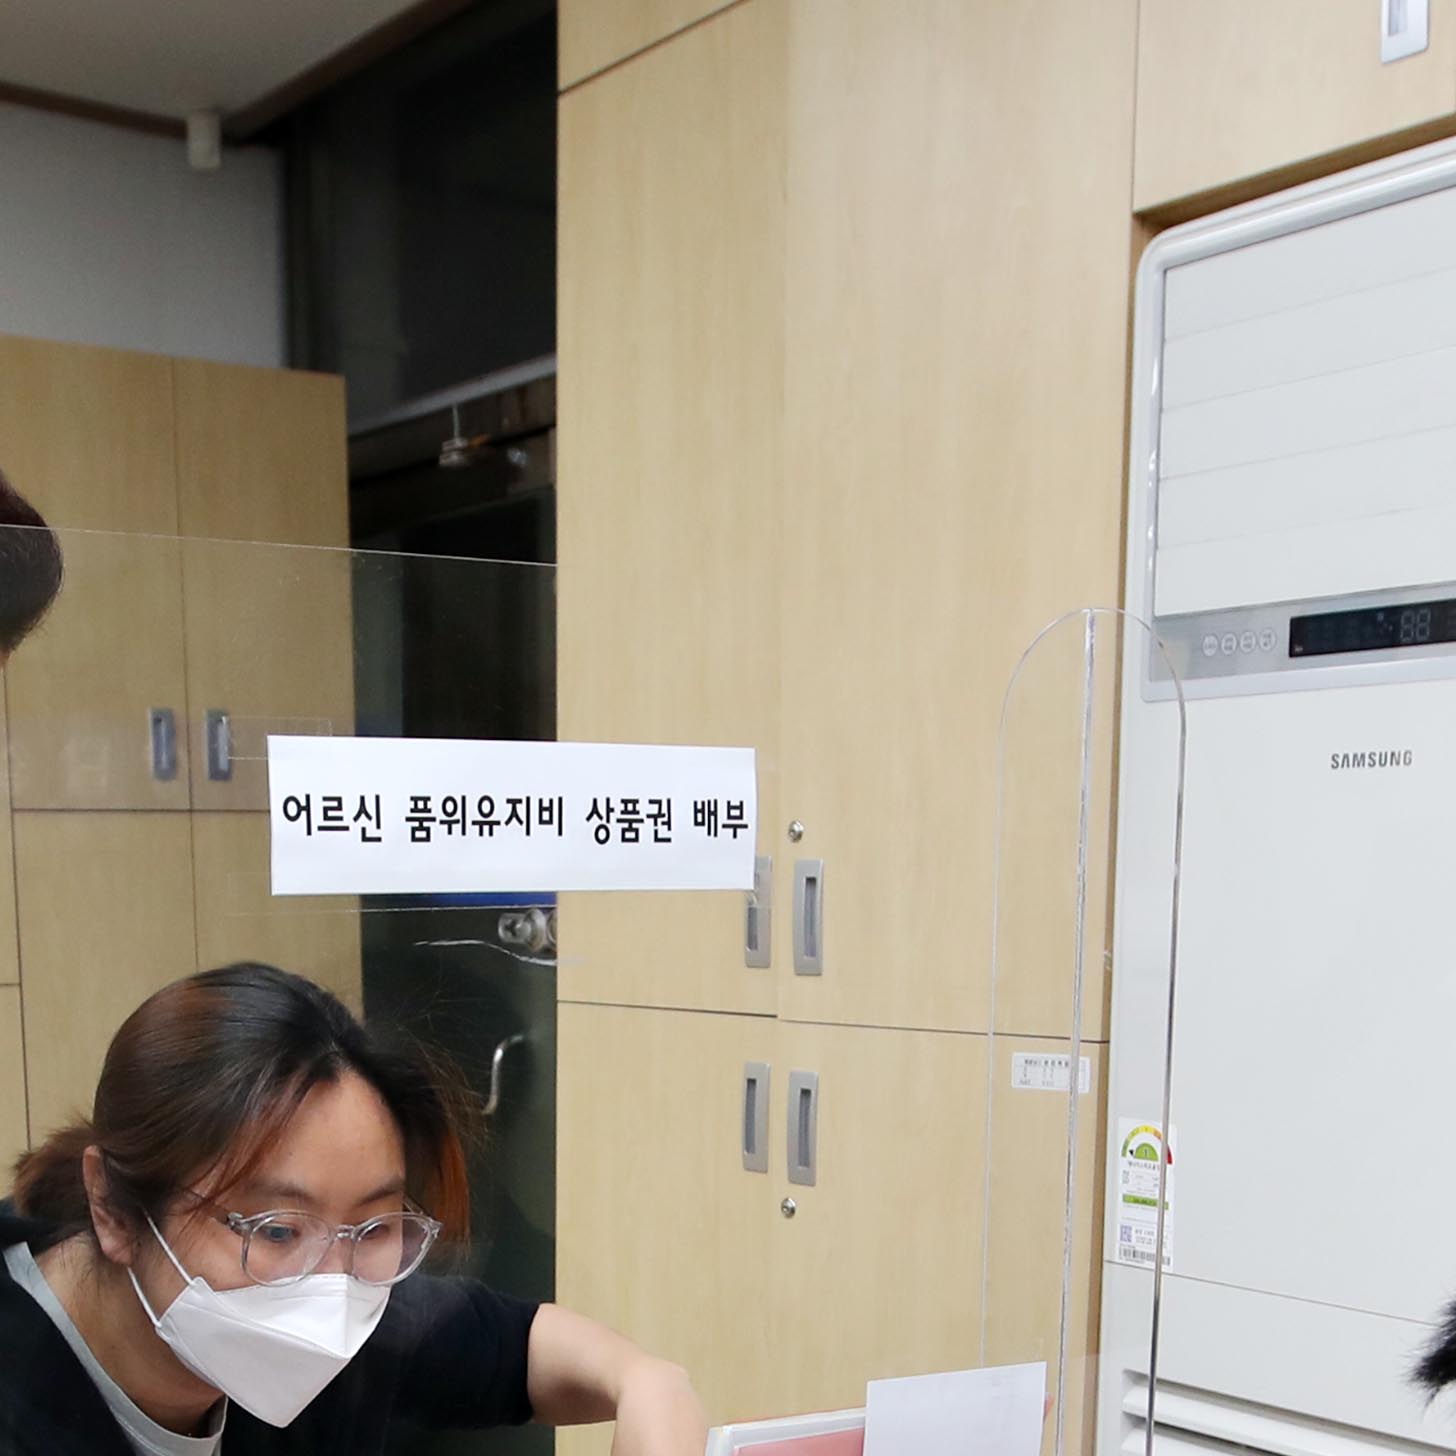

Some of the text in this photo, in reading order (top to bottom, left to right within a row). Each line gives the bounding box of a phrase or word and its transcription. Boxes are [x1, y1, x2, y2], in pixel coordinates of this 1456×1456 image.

[1330, 750, 1413, 770] SAMSUNG
[282, 793, 749, 846] 어르신 품위유지비 상품권 배부
